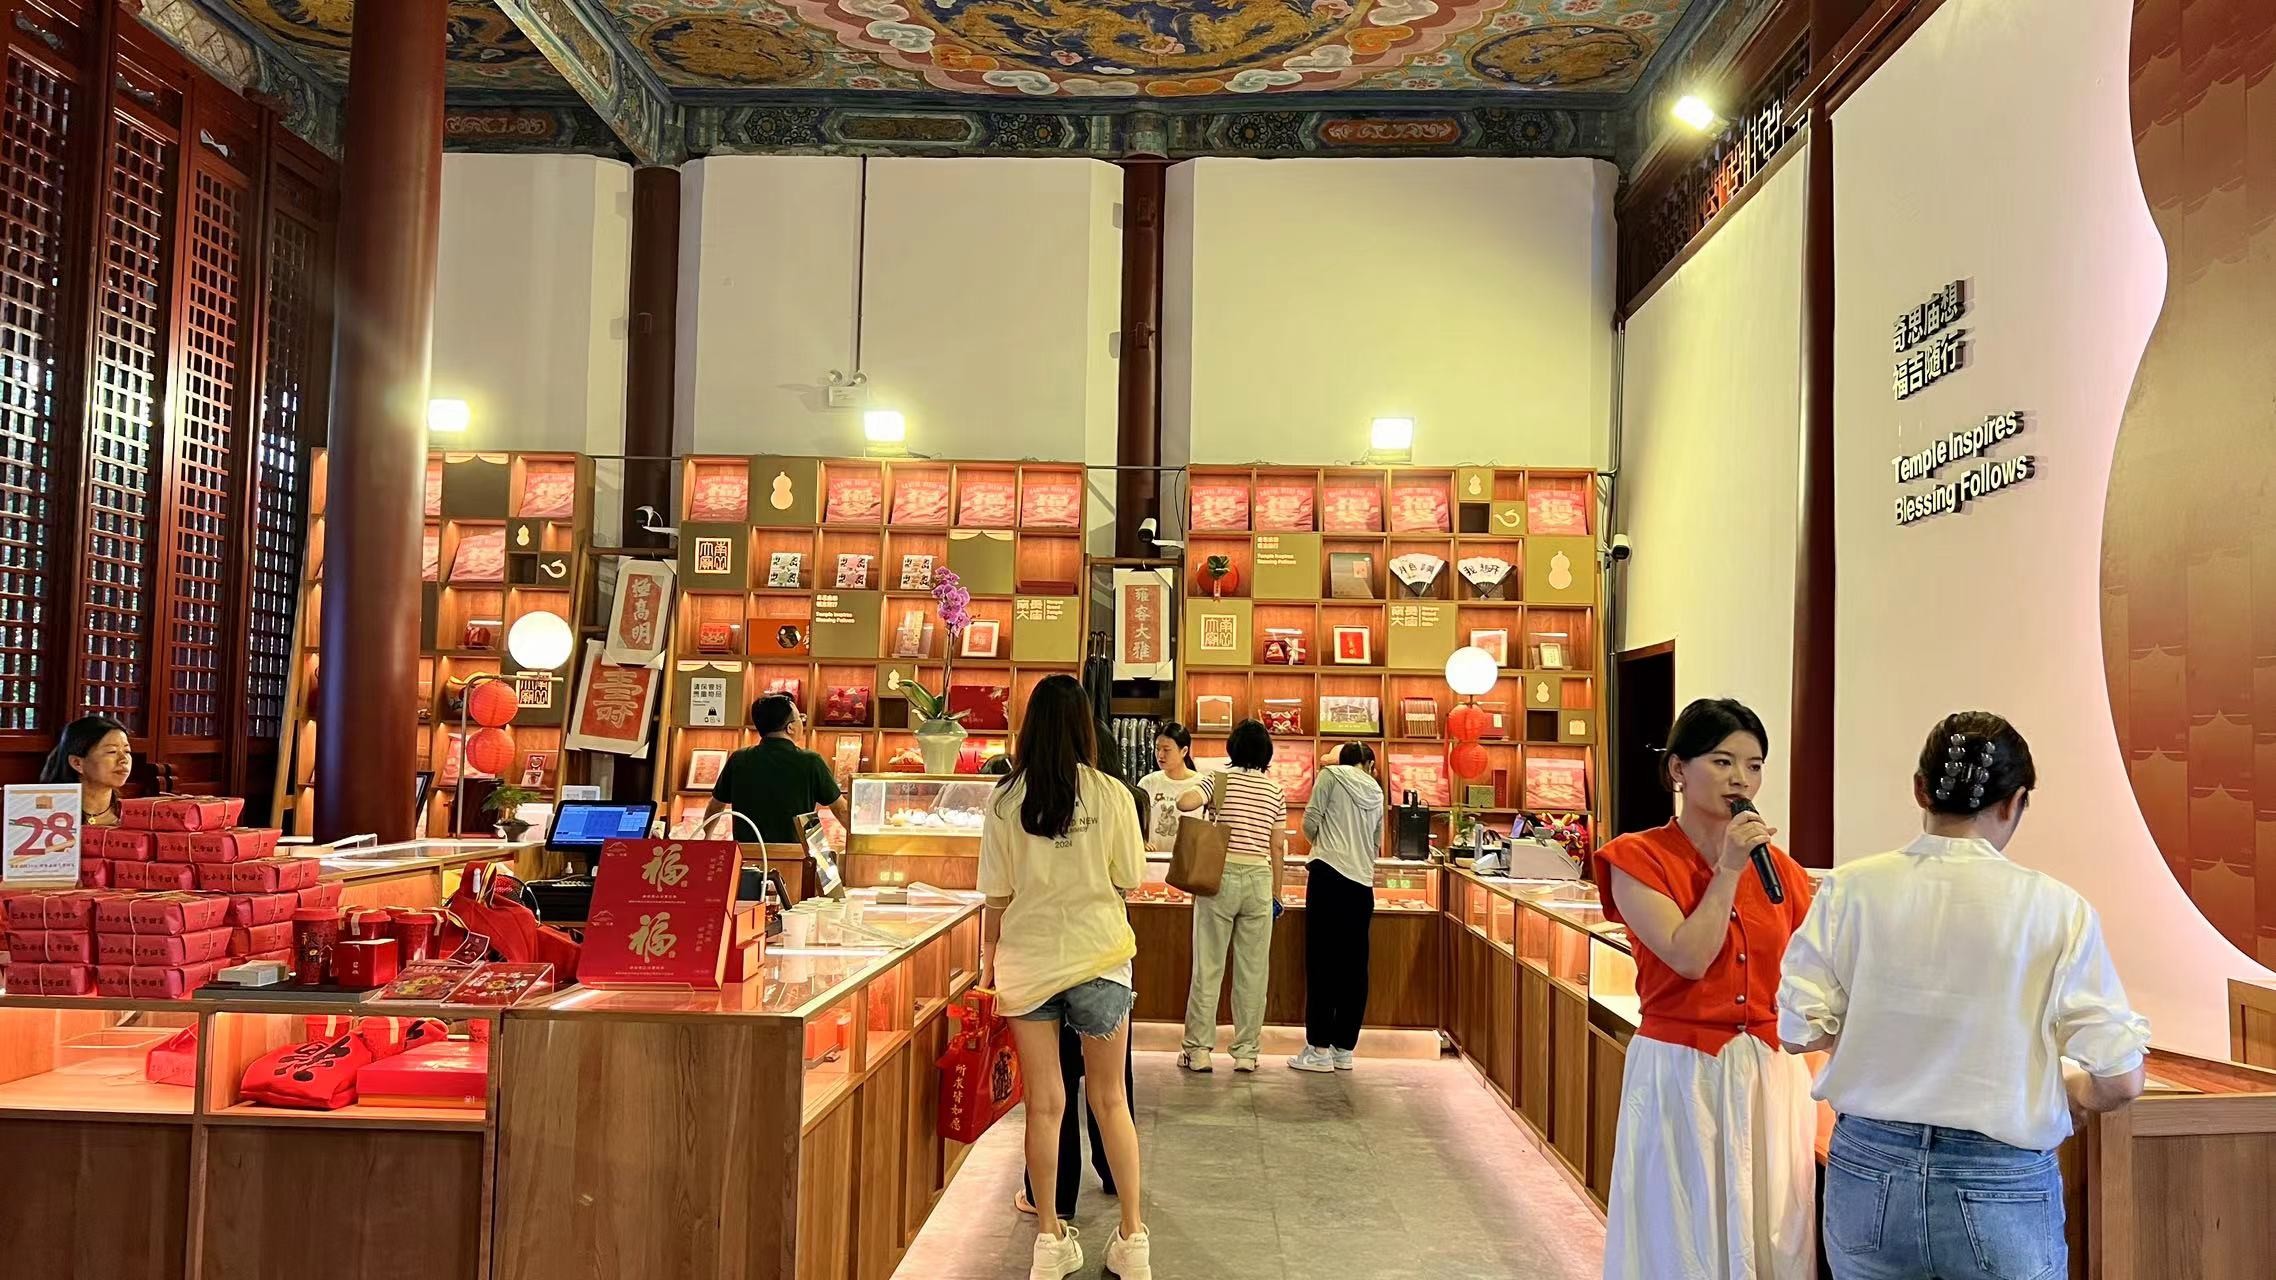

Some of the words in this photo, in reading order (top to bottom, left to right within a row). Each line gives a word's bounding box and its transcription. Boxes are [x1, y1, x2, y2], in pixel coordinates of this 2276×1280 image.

[1892, 440, 1950, 483] Temple
[1949, 411, 2021, 459] Inspires
[1895, 483, 1957, 525] Blessing
[1959, 455, 2031, 501] Follows
[13, 811, 76, 856] 28
[1079, 816, 1098, 825] NEW
[641, 843, 690, 893] 福
[627, 911, 678, 964] 福
